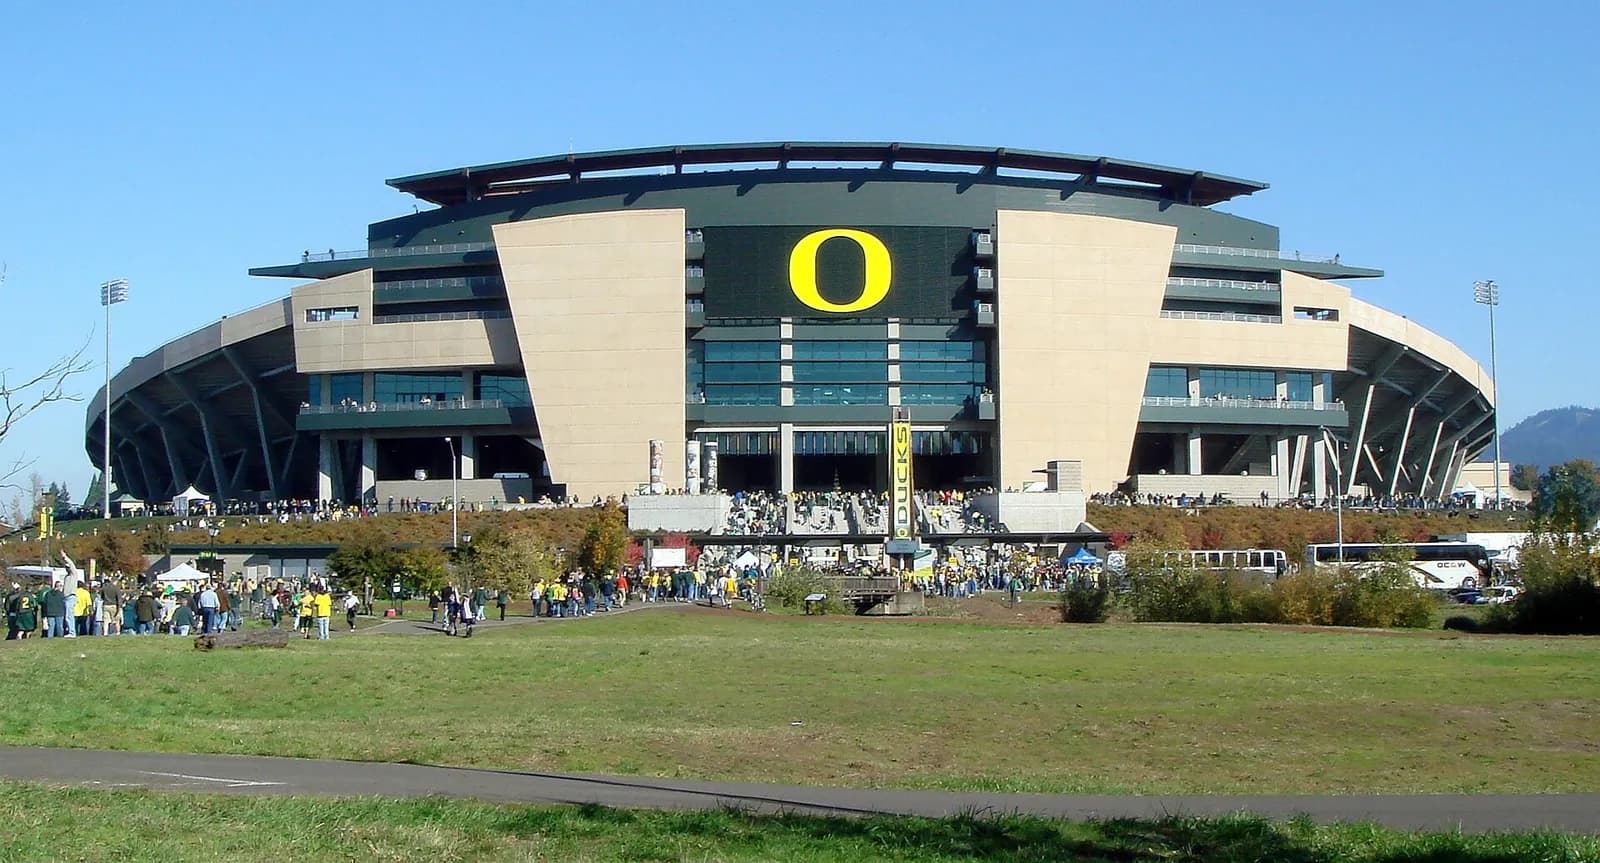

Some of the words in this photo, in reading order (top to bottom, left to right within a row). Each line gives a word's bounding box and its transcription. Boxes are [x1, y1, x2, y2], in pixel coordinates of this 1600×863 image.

[788, 228, 893, 313] O
[897, 426, 908, 524] DUCKS
[22, 597, 30, 609] 2
